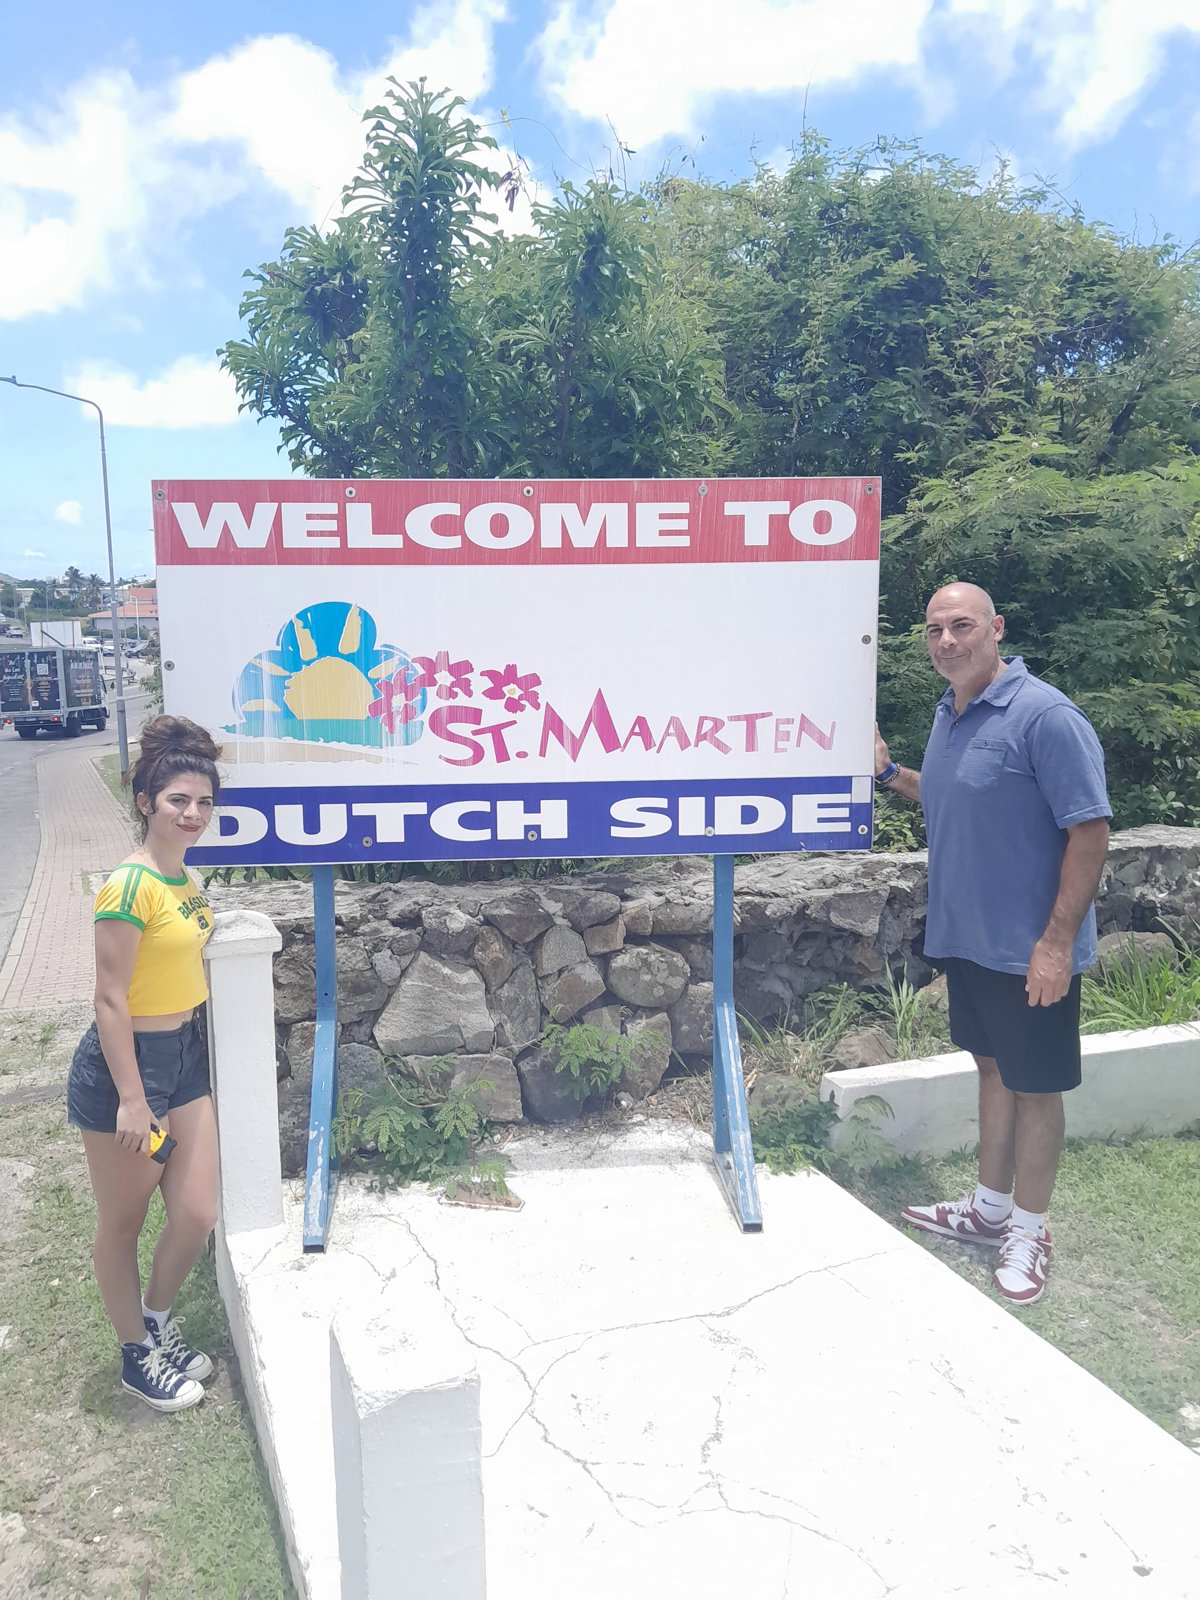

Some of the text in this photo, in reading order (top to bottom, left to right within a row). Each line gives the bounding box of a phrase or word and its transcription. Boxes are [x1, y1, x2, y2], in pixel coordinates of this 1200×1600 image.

[171, 500, 857, 549] WELCOME TO
[428, 704, 529, 767] ST.
[194, 793, 852, 846] DUTCH SIDE
[177, 896, 210, 920] BRASIL
